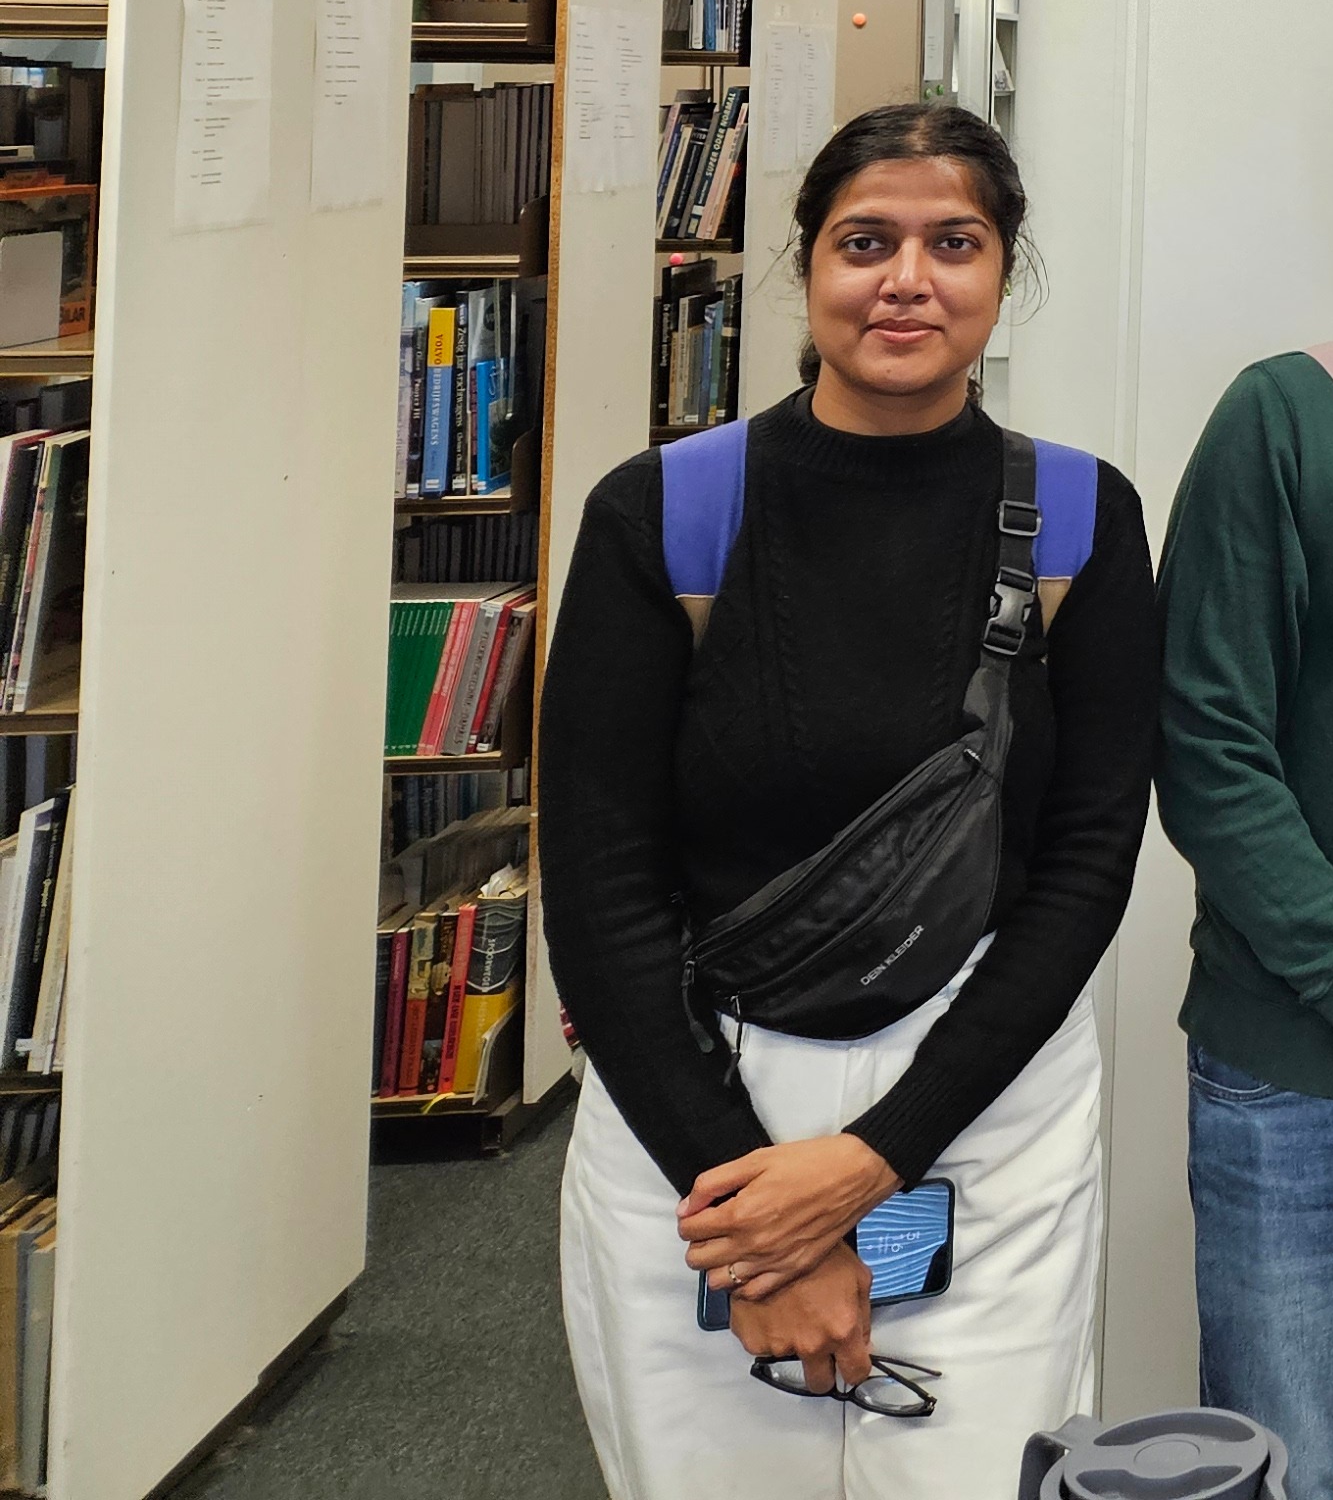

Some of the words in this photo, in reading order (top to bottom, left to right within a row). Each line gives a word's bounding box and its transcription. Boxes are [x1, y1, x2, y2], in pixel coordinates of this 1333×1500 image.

[706, 152, 718, 176] SUPER
[712, 130, 724, 151] ODER
[720, 91, 736, 128] NORMAL
[435, 334, 443, 365] VOLVO
[430, 368, 441, 445] BEDRIJFSWAGENS
[860, 964, 886, 985] DEIN
[884, 925, 924, 965] KLEIDER
